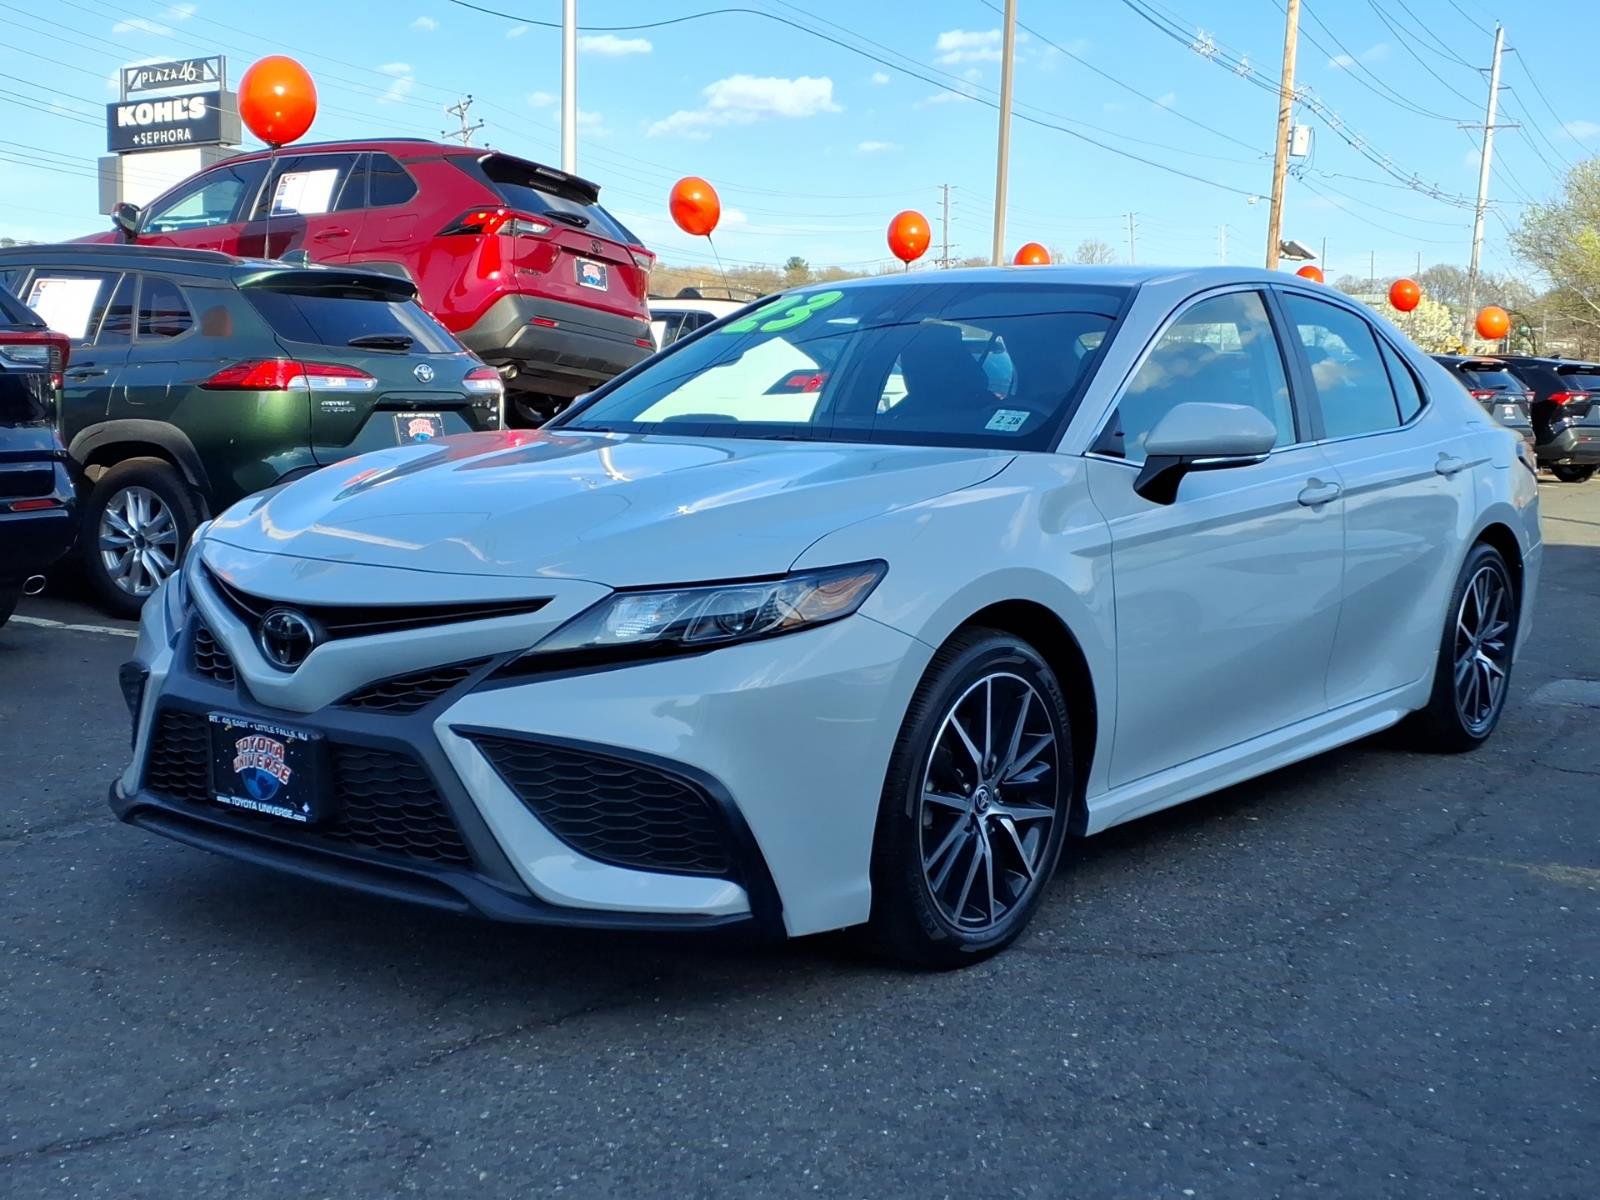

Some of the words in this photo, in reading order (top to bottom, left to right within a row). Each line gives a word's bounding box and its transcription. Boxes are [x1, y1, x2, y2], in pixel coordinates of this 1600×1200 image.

[142, 69, 177, 83] PLAZA
[179, 62, 196, 81] 46
[118, 97, 206, 126] KOHL'S
[995, 415, 1005, 424] 2
[231, 719, 248, 728] EAST
[254, 723, 275, 733] LITTLE
[298, 732, 308, 741] NJ
[235, 734, 285, 761] TOYOTA
[232, 751, 292, 785] UNIVERSE
